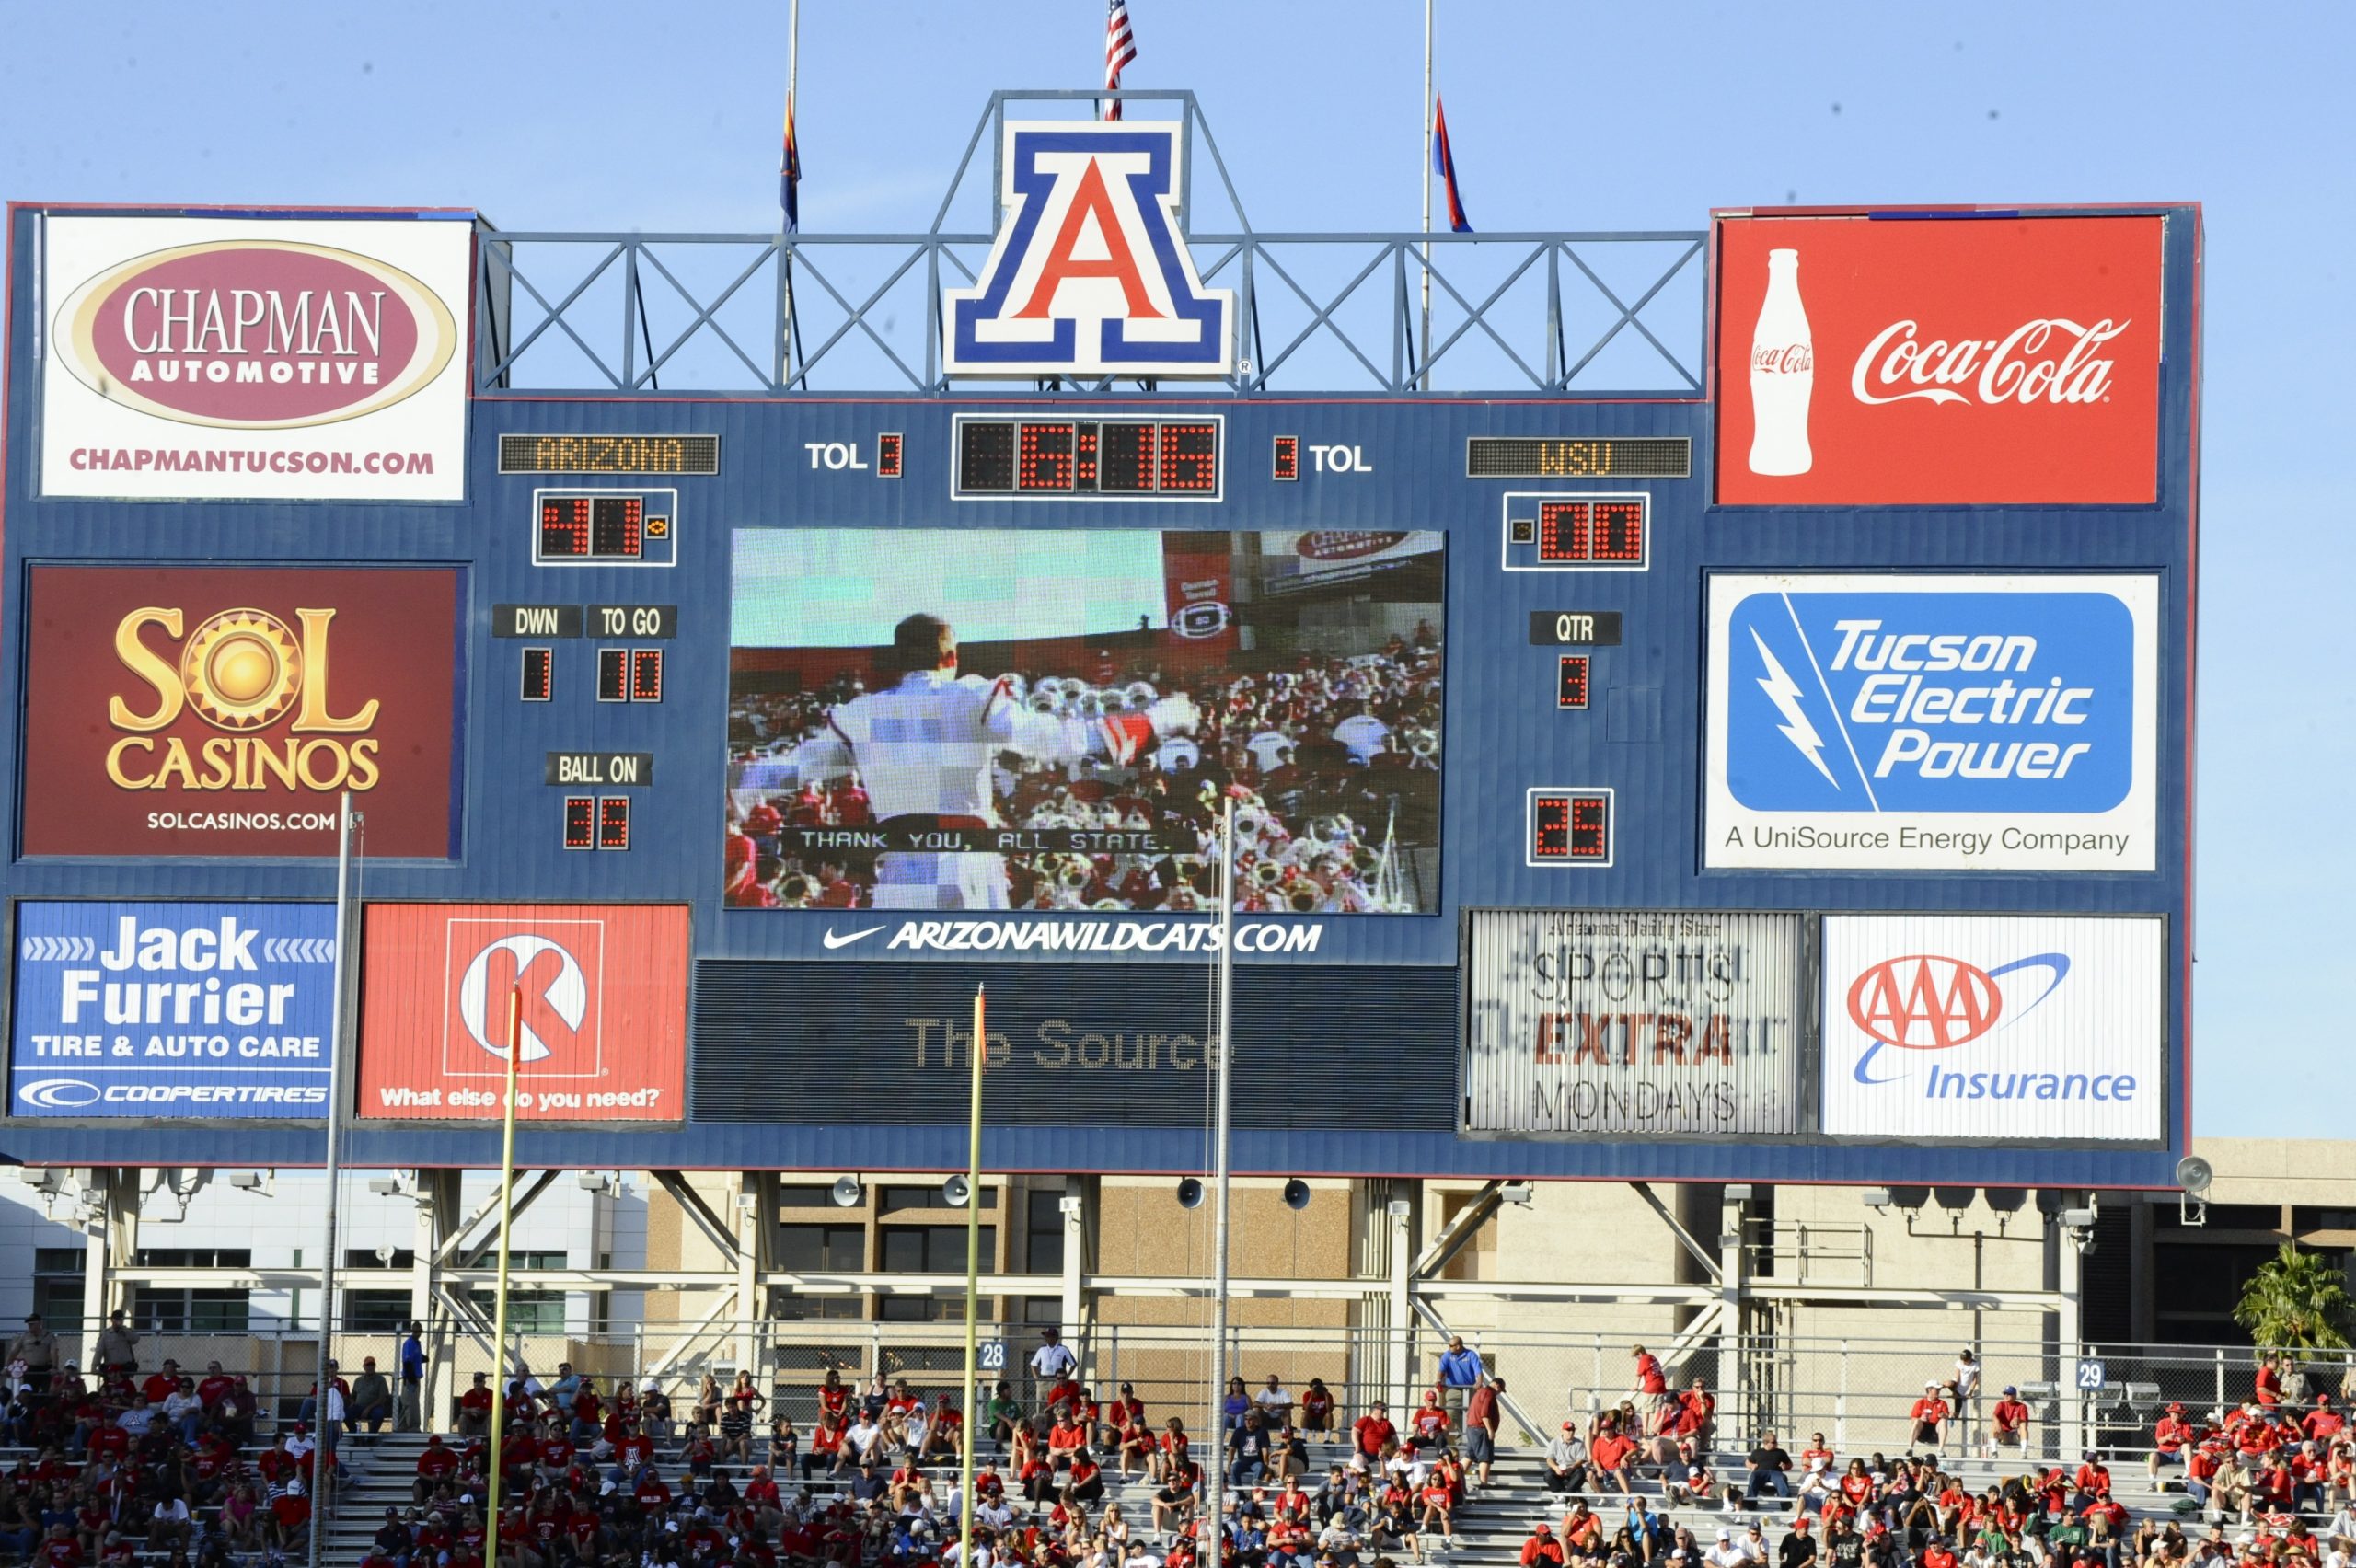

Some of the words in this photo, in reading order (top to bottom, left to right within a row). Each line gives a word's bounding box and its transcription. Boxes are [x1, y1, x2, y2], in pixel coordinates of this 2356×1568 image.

[942, 121, 1235, 381] A
[122, 287, 387, 359] CHAPMAN
[130, 360, 379, 385] AUTOMOTIVE
[69, 448, 434, 475] CHAPMANTUCSON.COM
[537, 437, 683, 472] ARIZONA
[804, 443, 869, 470] TOL
[880, 436, 902, 475] 3
[1275, 438, 1296, 478] 3
[1308, 445, 1373, 472] TOL
[1540, 442, 1611, 475] WSU
[543, 499, 641, 554] 41
[1542, 503, 1641, 559] 00
[515, 608, 558, 634] DWN
[602, 608, 626, 635] TO
[632, 608, 661, 635] GO
[1556, 615, 1593, 641] QTR
[1830, 619, 2038, 672] Tucson
[109, 606, 380, 733] SOL
[618, 652, 661, 697] 10
[1561, 658, 1587, 703] 3
[1850, 674, 2095, 724] Electric
[105, 736, 380, 790] CASINOS
[559, 756, 603, 782] BALL
[609, 756, 638, 782] ON
[1872, 728, 2092, 779] Power
[147, 812, 336, 832] SOLCASINOS.COM
[566, 801, 627, 845] 35
[801, 831, 888, 848] THANK
[908, 832, 972, 851] YOU,
[998, 833, 1051, 850] ALL
[1070, 834, 1170, 850] STATE.
[1537, 800, 1603, 854] 25
[1725, 826, 1745, 848] A
[1753, 825, 1890, 849] UniSource
[1899, 826, 1993, 855] Energy
[2001, 827, 2130, 856] Company
[100, 916, 260, 971] Jack
[887, 921, 1323, 952] ARIZONAWILDCATSCOM
[1531, 952, 1735, 1003] SPORTS
[61, 970, 295, 1026] Furrier
[1866, 957, 1988, 1046] AAA
[31, 1035, 102, 1057] TIRE
[111, 1035, 134, 1057] &
[144, 1036, 229, 1058] AUTO
[238, 1036, 320, 1058] CARE
[905, 1018, 1011, 1068] The
[1034, 1019, 1236, 1071] Source
[1535, 1012, 1735, 1066] EXTRA
[103, 1085, 329, 1103] COOPERTIRES
[380, 1087, 442, 1107] What
[447, 1087, 497, 1107] else
[538, 1092, 581, 1112] you
[586, 1088, 660, 1108] need?
[1533, 1080, 1735, 1122] MONDAYS
[1925, 1064, 2137, 1101] Insurance
[983, 1343, 1003, 1366] 28
[2080, 1363, 2101, 1387] 29
